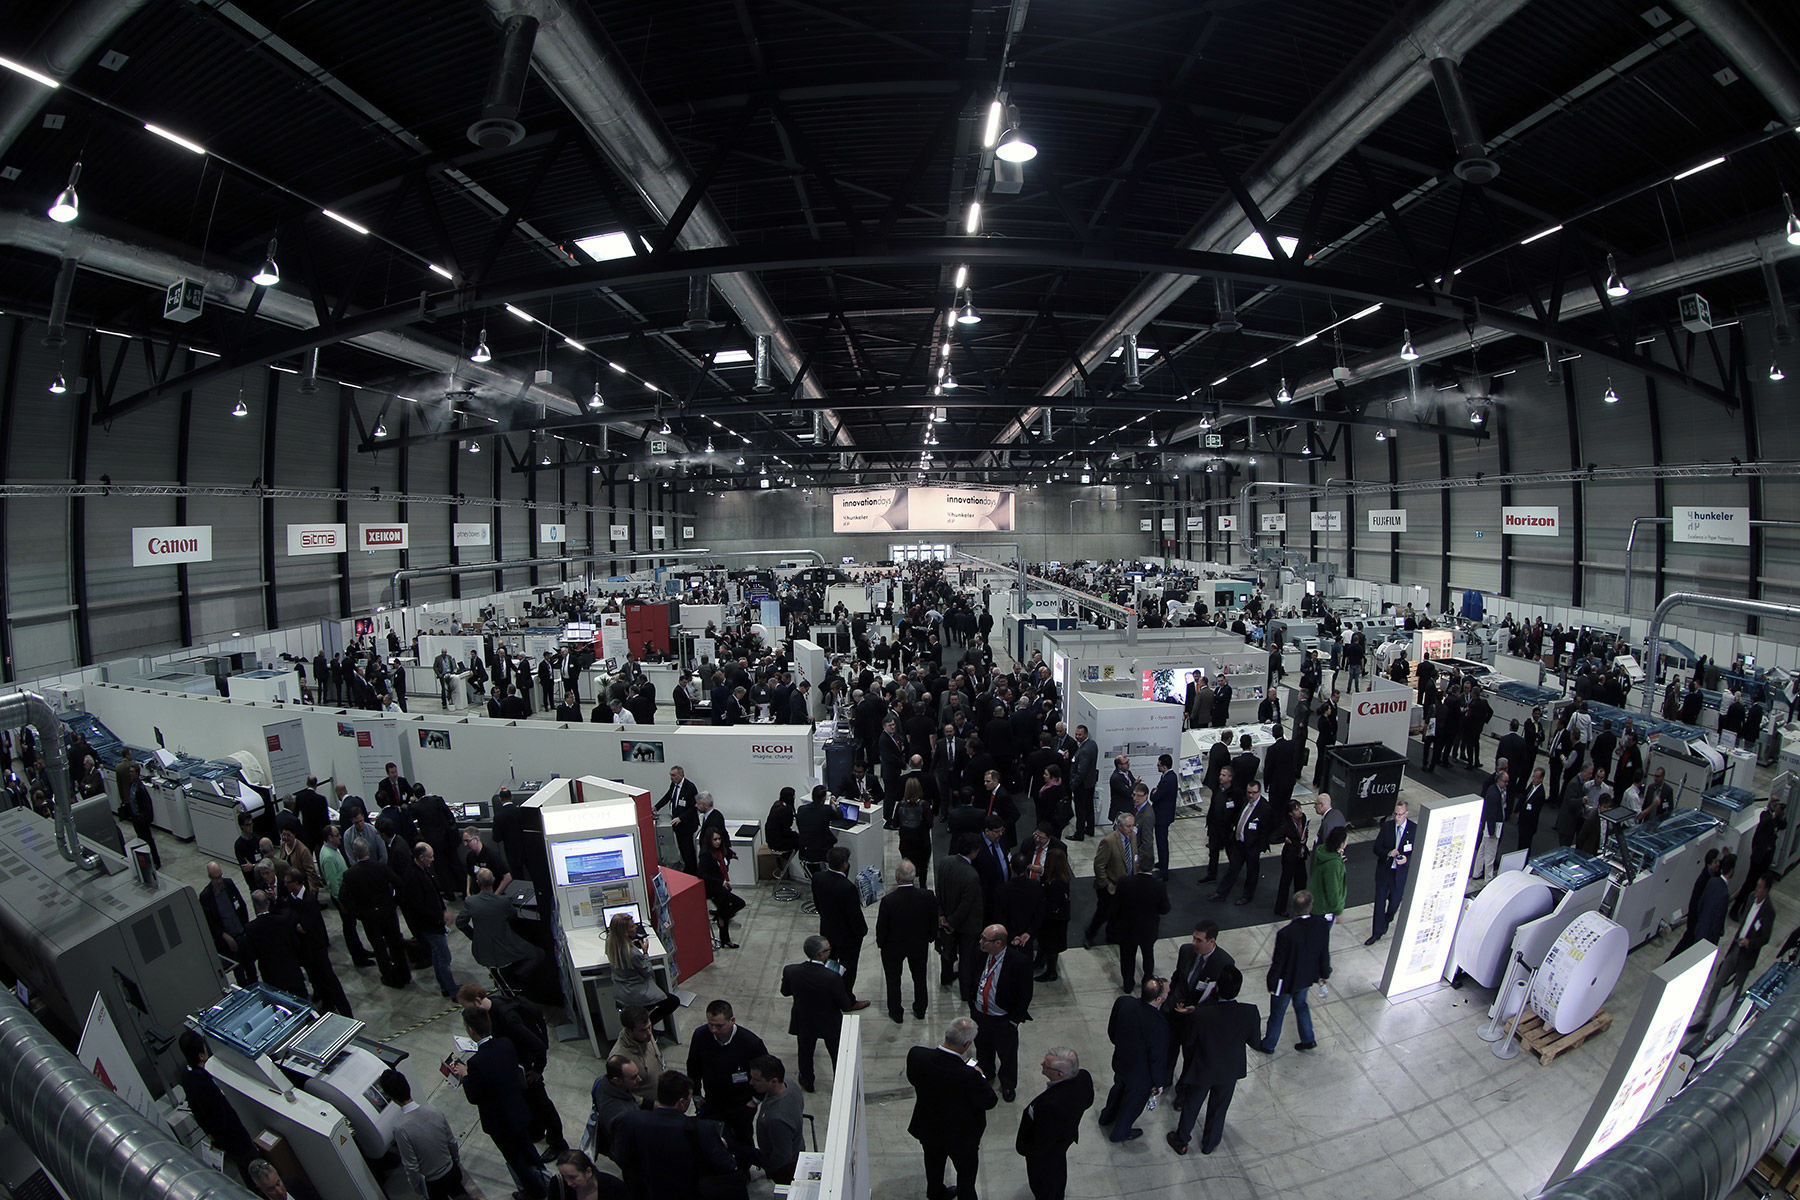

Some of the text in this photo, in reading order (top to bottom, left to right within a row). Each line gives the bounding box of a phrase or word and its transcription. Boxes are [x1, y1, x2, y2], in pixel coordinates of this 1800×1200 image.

[842, 495, 892, 507] innovationdays
[947, 494, 996, 507] innovationdays
[1373, 516, 1401, 526] FUJIFILM
[1505, 514, 1555, 527] Horizon
[1694, 511, 1734, 520] hunkeler
[302, 534, 335, 545] sitma
[368, 532, 401, 542] XEIKON
[148, 537, 198, 555] Canon
[1358, 700, 1407, 716] Canon
[752, 745, 793, 753] RICOH
